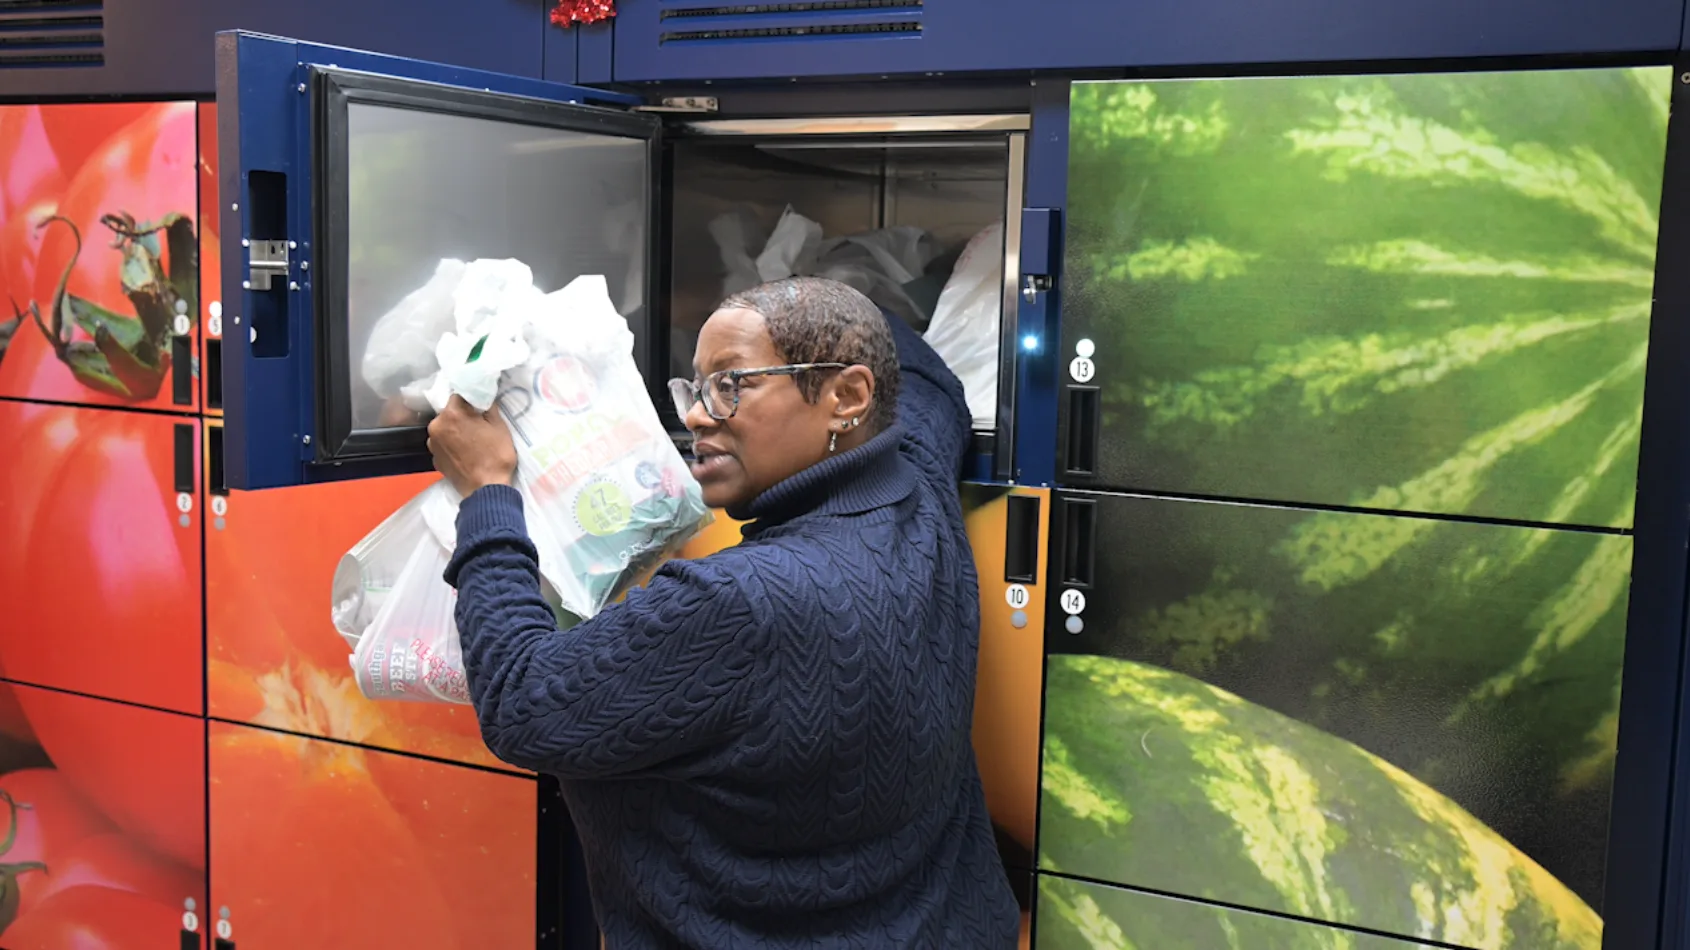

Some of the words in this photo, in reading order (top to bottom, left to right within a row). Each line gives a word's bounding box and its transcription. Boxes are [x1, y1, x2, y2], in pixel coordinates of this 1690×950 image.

[1076, 361, 1089, 378] 13
[1011, 588, 1024, 605] 10
[1067, 594, 1080, 611] 14
[390, 643, 406, 692] BEEF
[405, 650, 418, 681] STE
[410, 638, 446, 673] PLEASE
